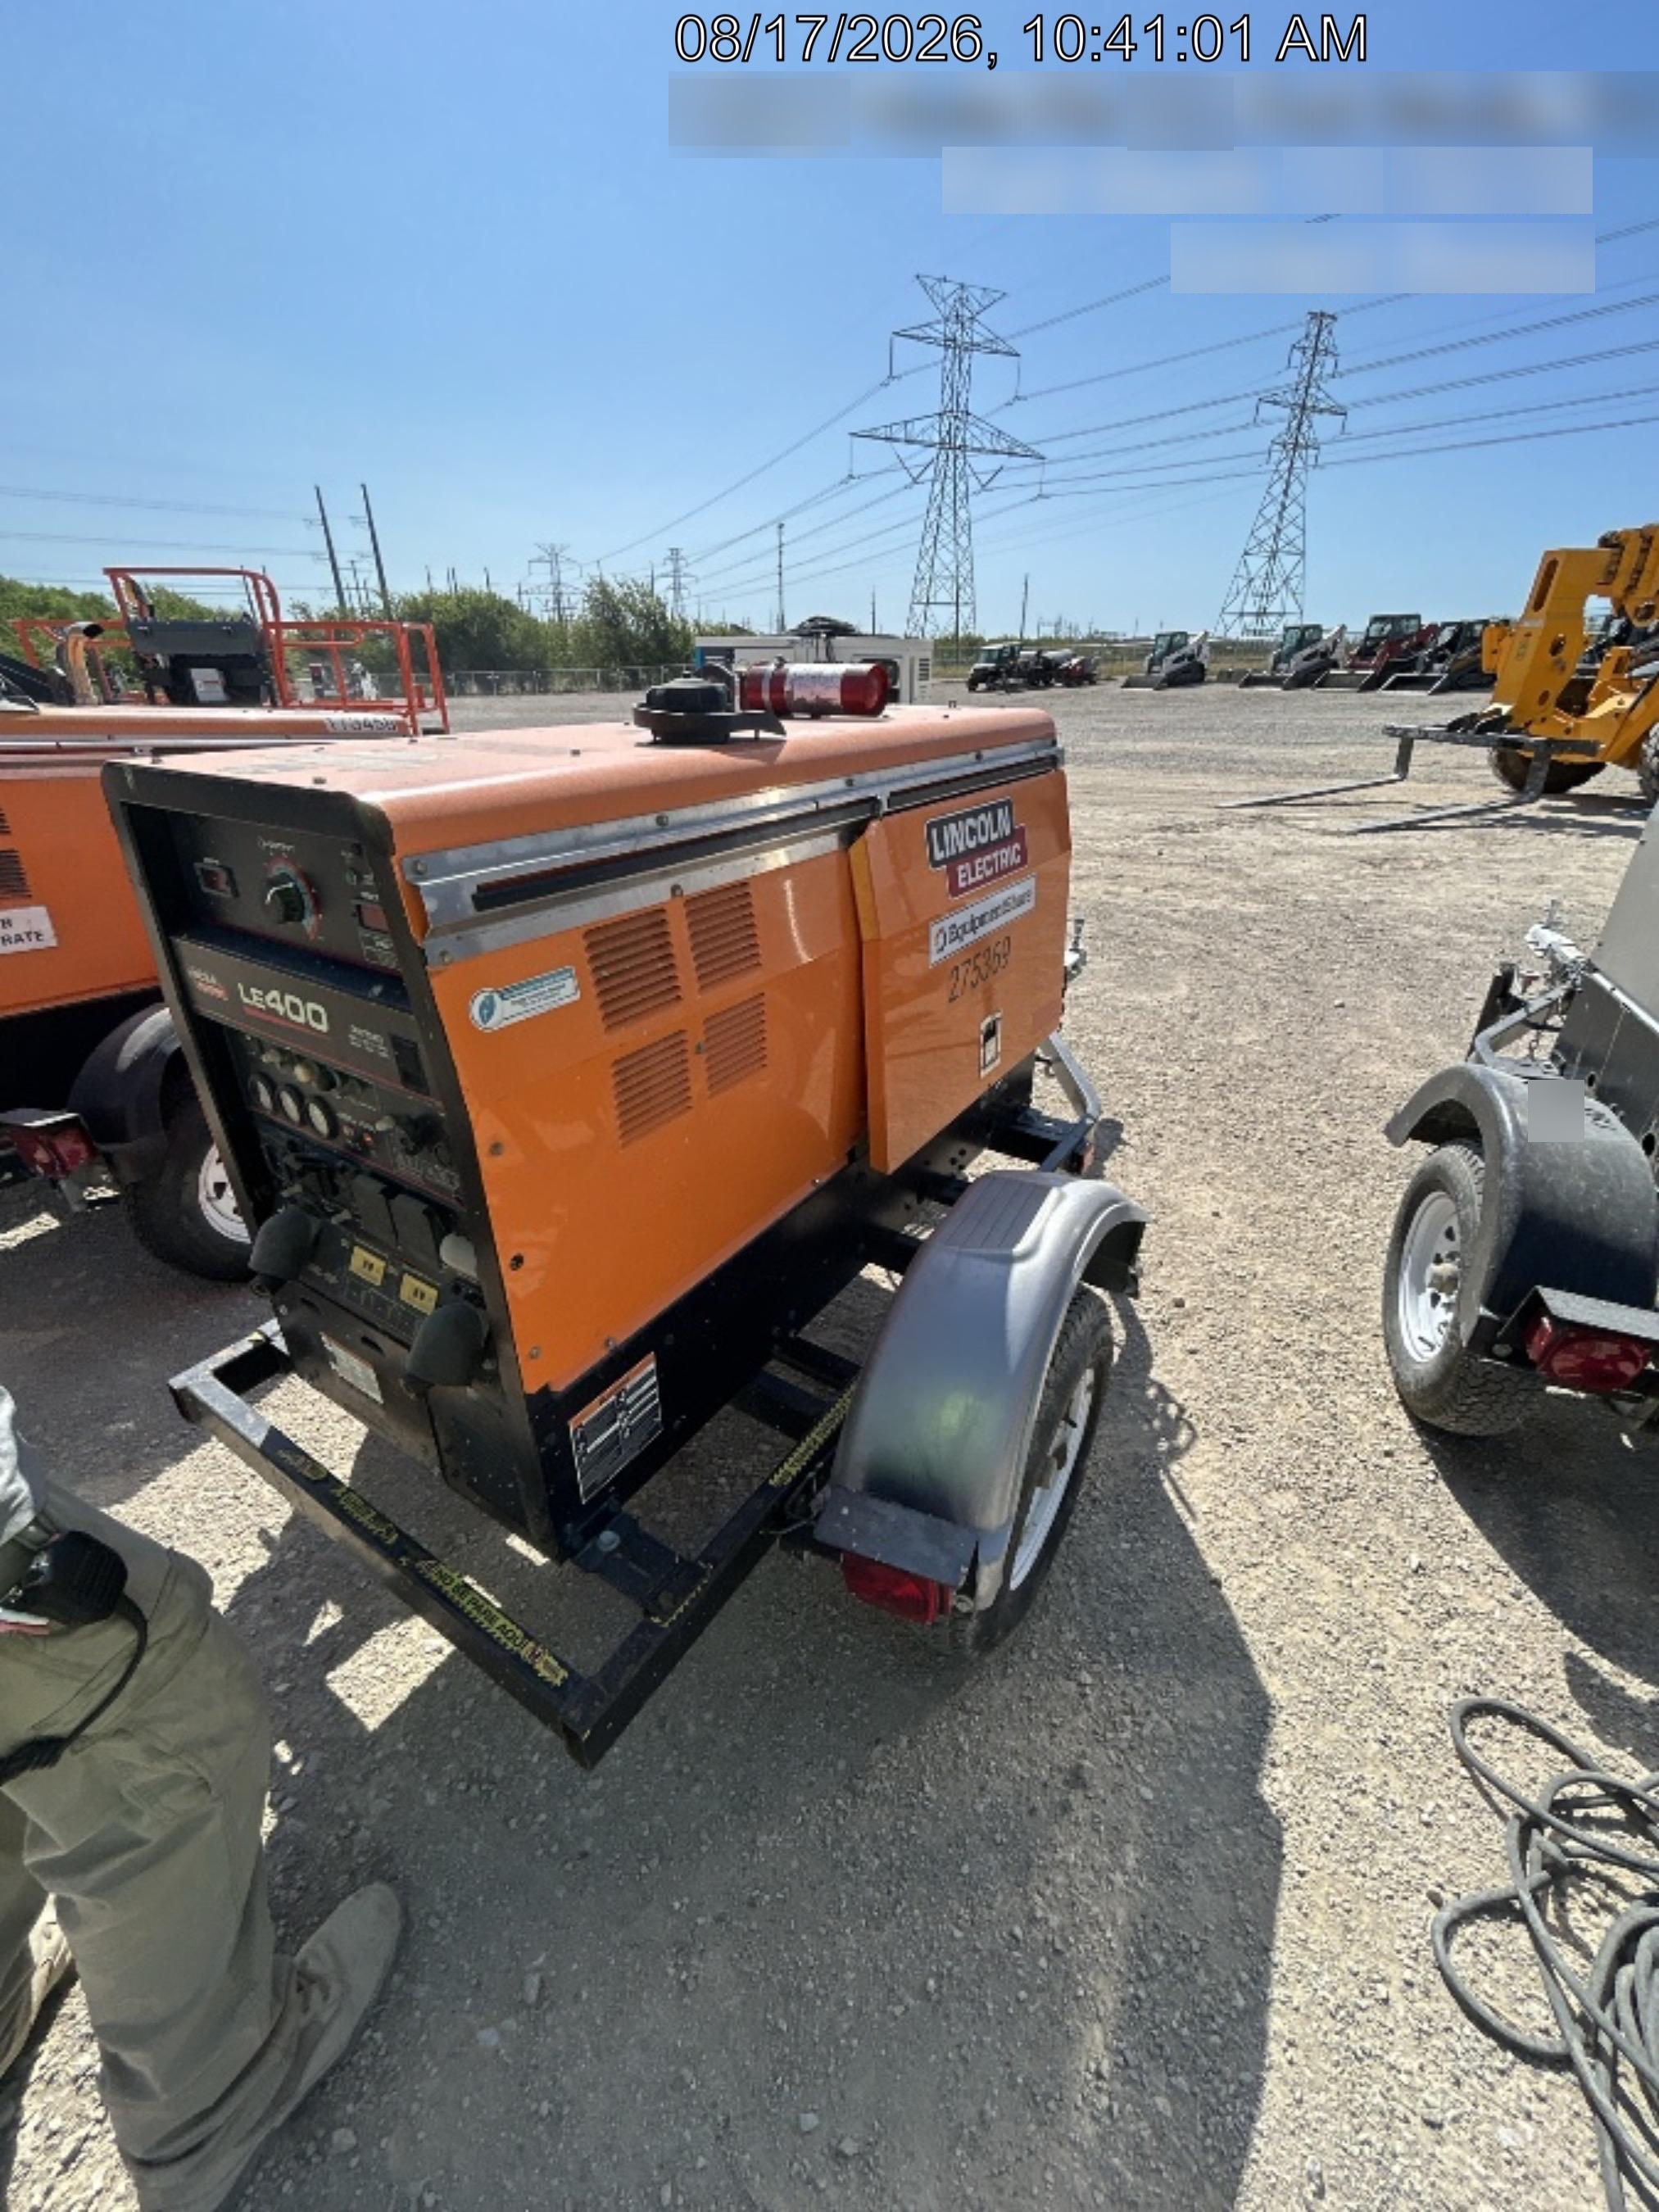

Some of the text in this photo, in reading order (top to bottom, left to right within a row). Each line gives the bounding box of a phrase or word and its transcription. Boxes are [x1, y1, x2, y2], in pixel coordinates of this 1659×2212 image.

[931, 805, 1012, 861] LINCOLN
[957, 842, 1022, 888] ELECTRIC
[947, 888, 1032, 943] EquipmentShare
[949, 936, 1012, 1004] 275369
[238, 982, 329, 1032] LE400
